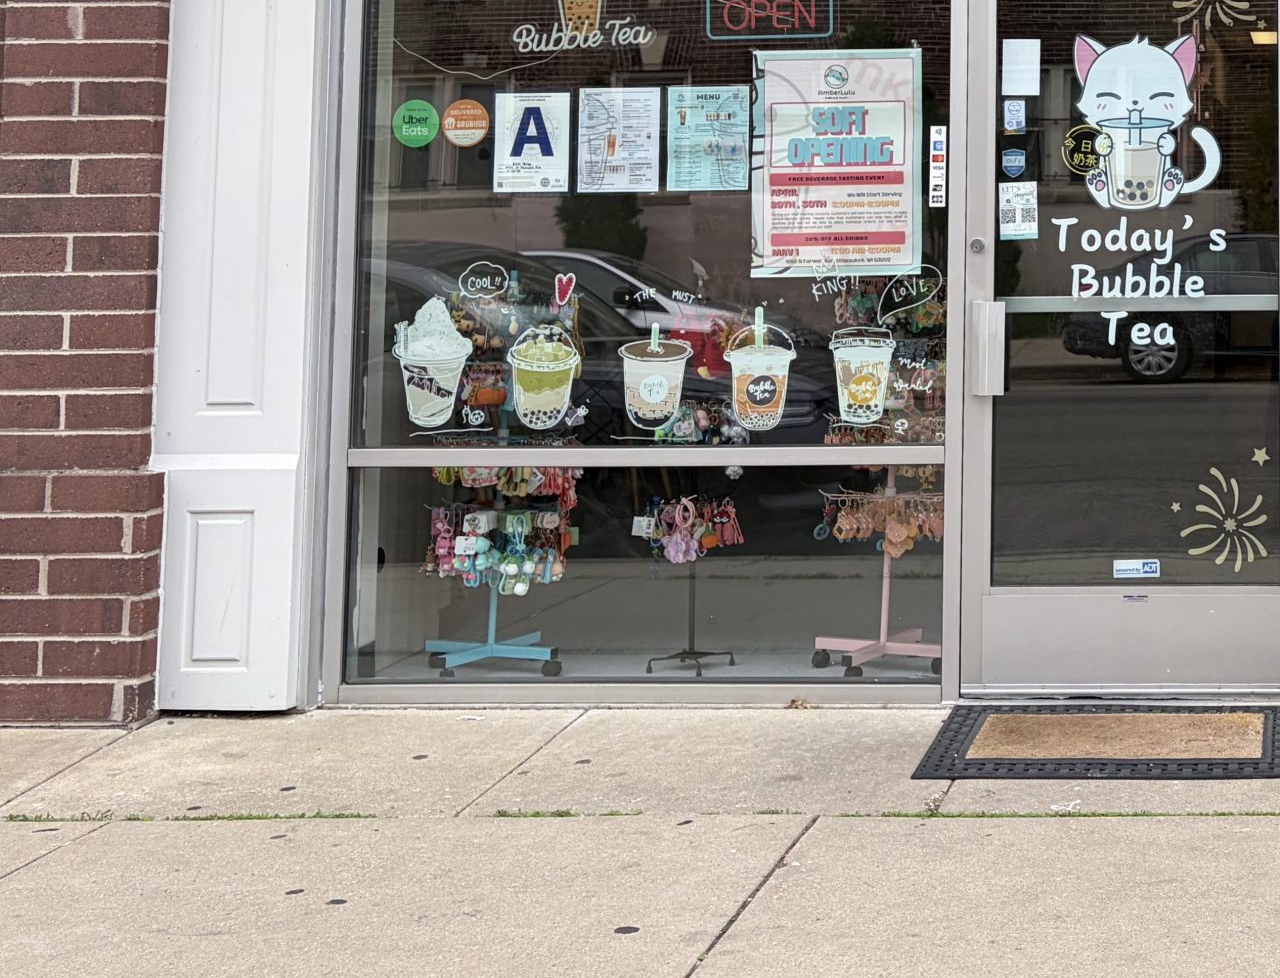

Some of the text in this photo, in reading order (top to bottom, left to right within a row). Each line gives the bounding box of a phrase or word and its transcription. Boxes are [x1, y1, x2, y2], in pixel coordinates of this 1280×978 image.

[723, 0, 816, 31] OPEN
[513, 17, 652, 53] Bubble Tea
[402, 114, 429, 125] Uber
[456, 120, 487, 128] GRUBHUB
[812, 106, 868, 136] SOFT
[402, 125, 429, 135] Eats
[510, 106, 554, 157] A
[787, 136, 893, 167] OPENING
[770, 188, 799, 197] APRIL
[1051, 215, 1227, 265] Today's
[467, 276, 502, 291] COOL!!
[891, 278, 928, 303] LOVE
[1071, 262, 1205, 299] Bubble
[671, 289, 696, 304] MUST
[1101, 310, 1175, 346] Tea
[748, 379, 776, 394] Bubble
[754, 390, 771, 402] Tea
[1143, 563, 1157, 572] ADT
